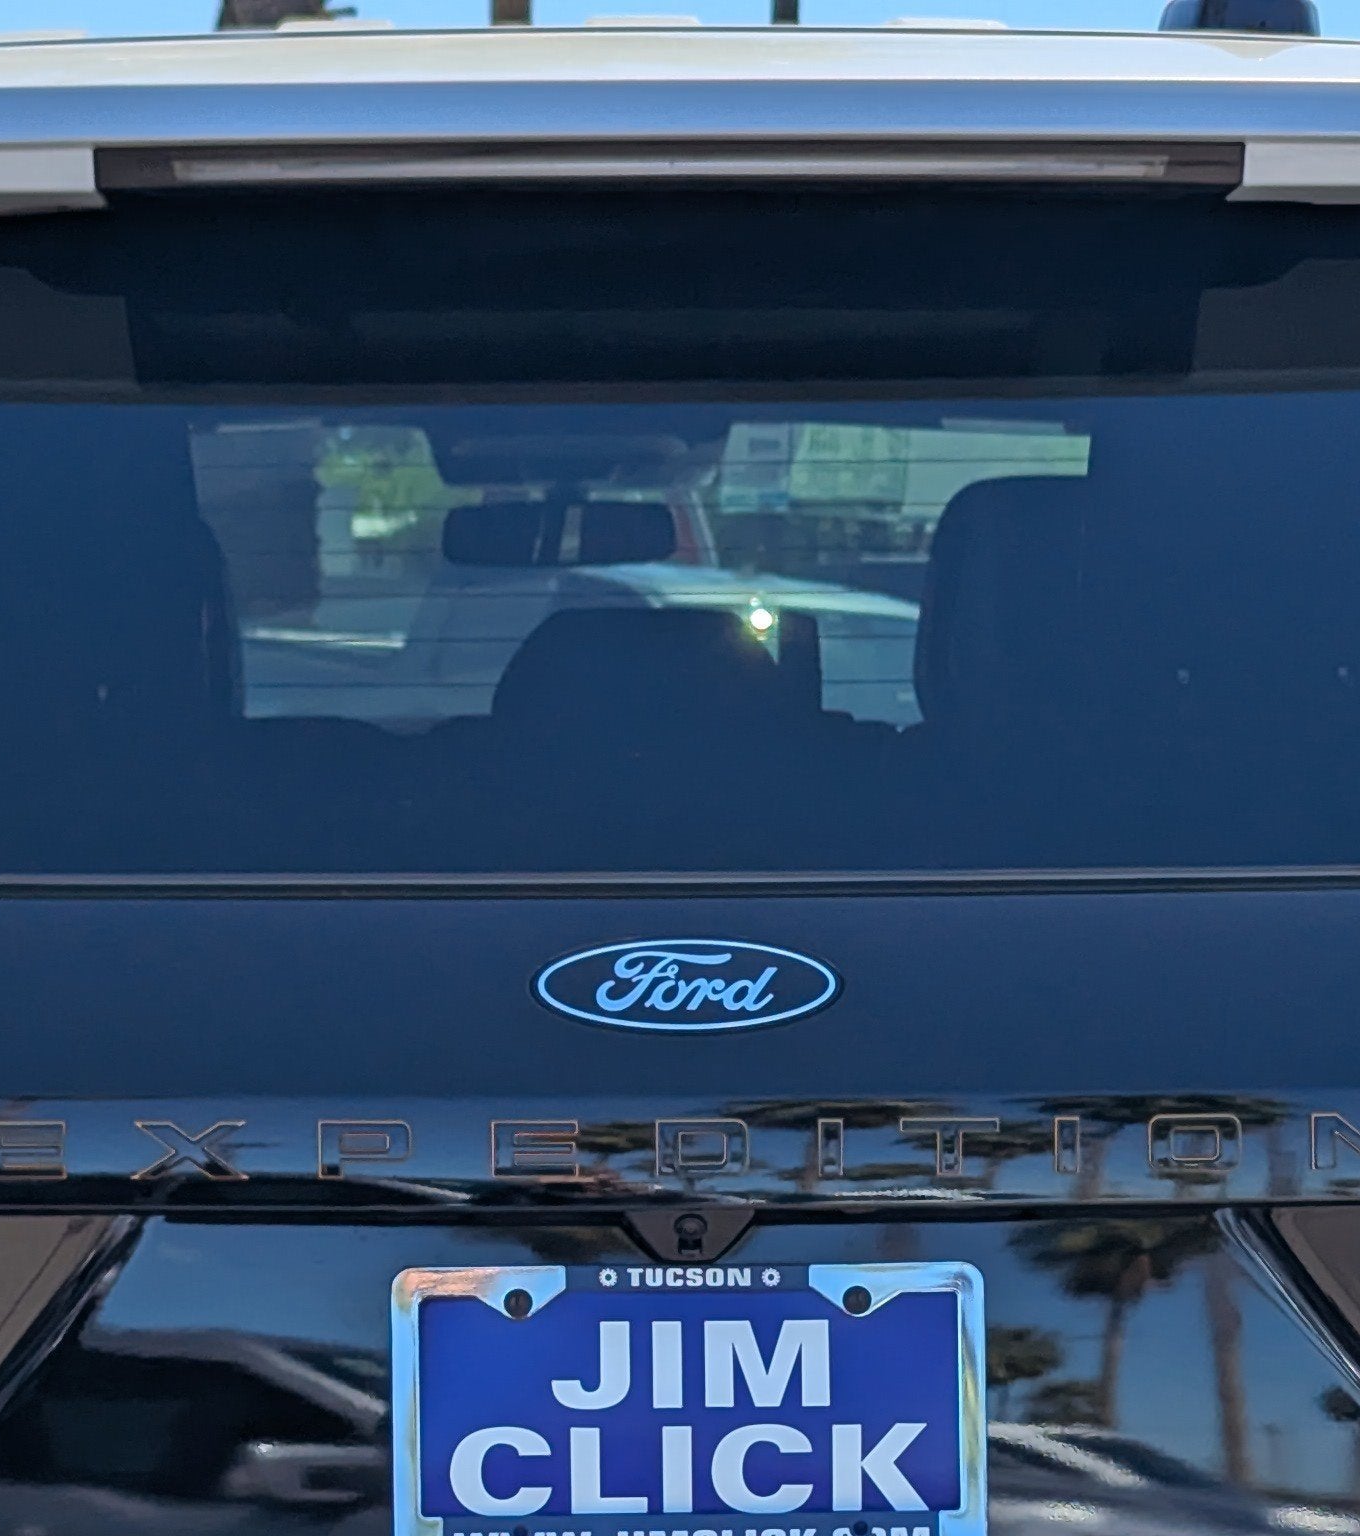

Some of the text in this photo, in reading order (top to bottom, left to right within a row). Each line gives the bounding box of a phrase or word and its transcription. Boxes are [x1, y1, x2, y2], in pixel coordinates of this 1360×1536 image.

[596, 950, 778, 1012] Ford
[626, 1267, 752, 1287] TUCSON
[551, 1319, 831, 1409] JIM
[449, 1422, 928, 1516] CLICK
